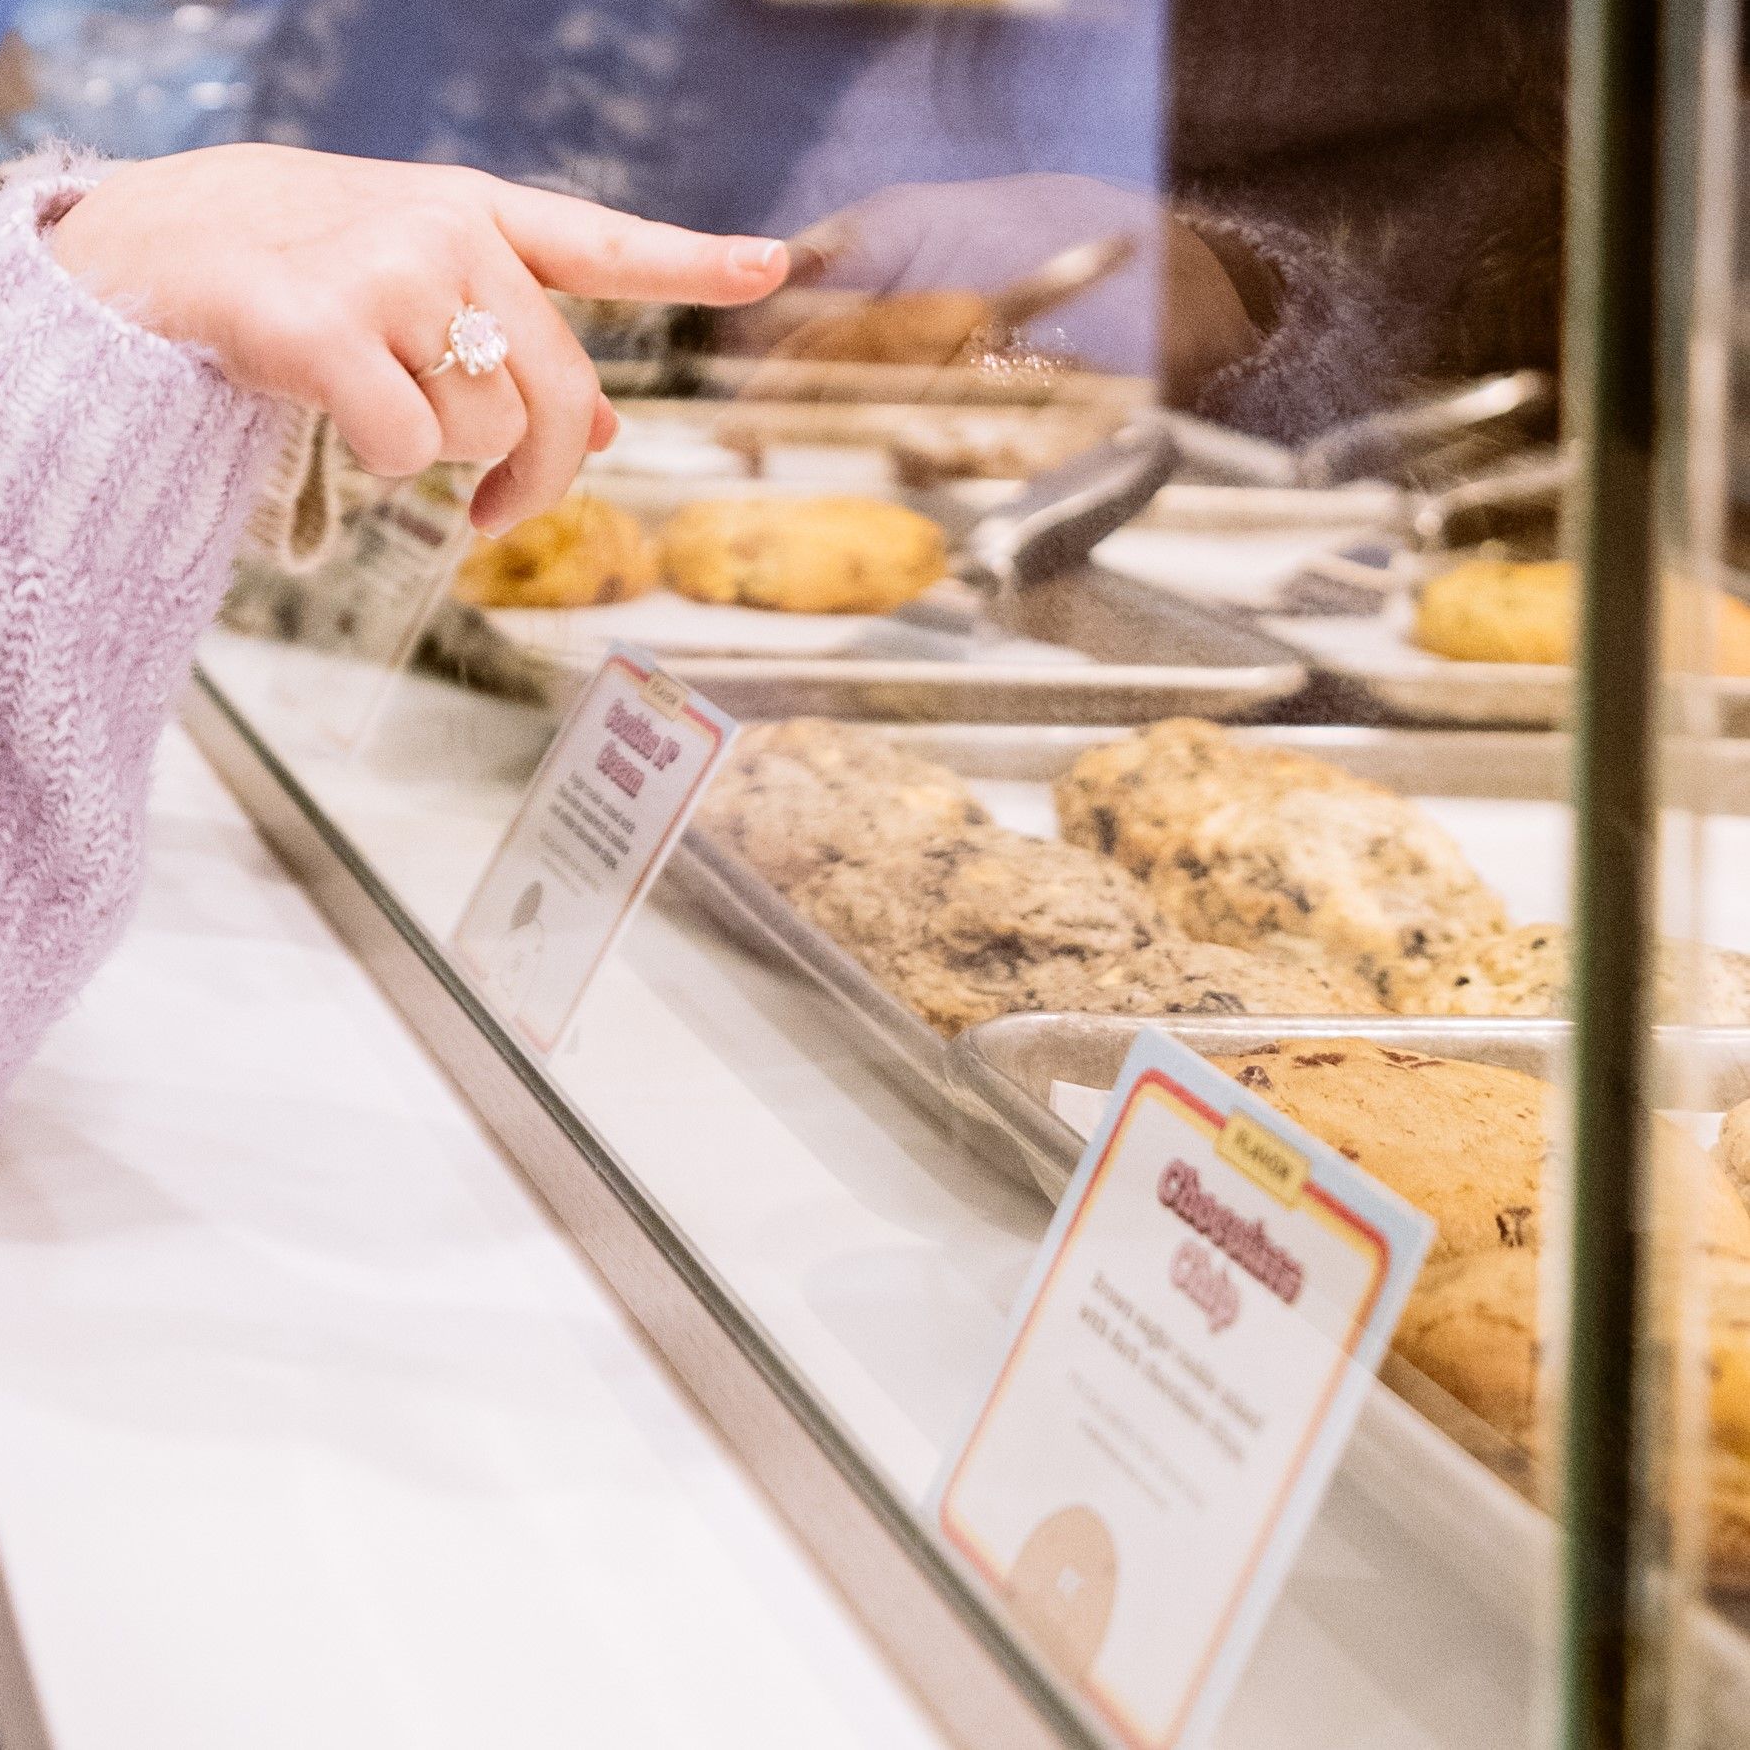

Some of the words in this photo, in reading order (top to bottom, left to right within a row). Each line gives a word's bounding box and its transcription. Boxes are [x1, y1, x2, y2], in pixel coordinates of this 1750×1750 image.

[604, 699, 661, 761] Cookies
[596, 741, 645, 800] Cream
[1235, 1131, 1291, 1182] FLAVOR
[1158, 1160, 1304, 1305] Chocolate
[1170, 1240, 1241, 1335] Chip
